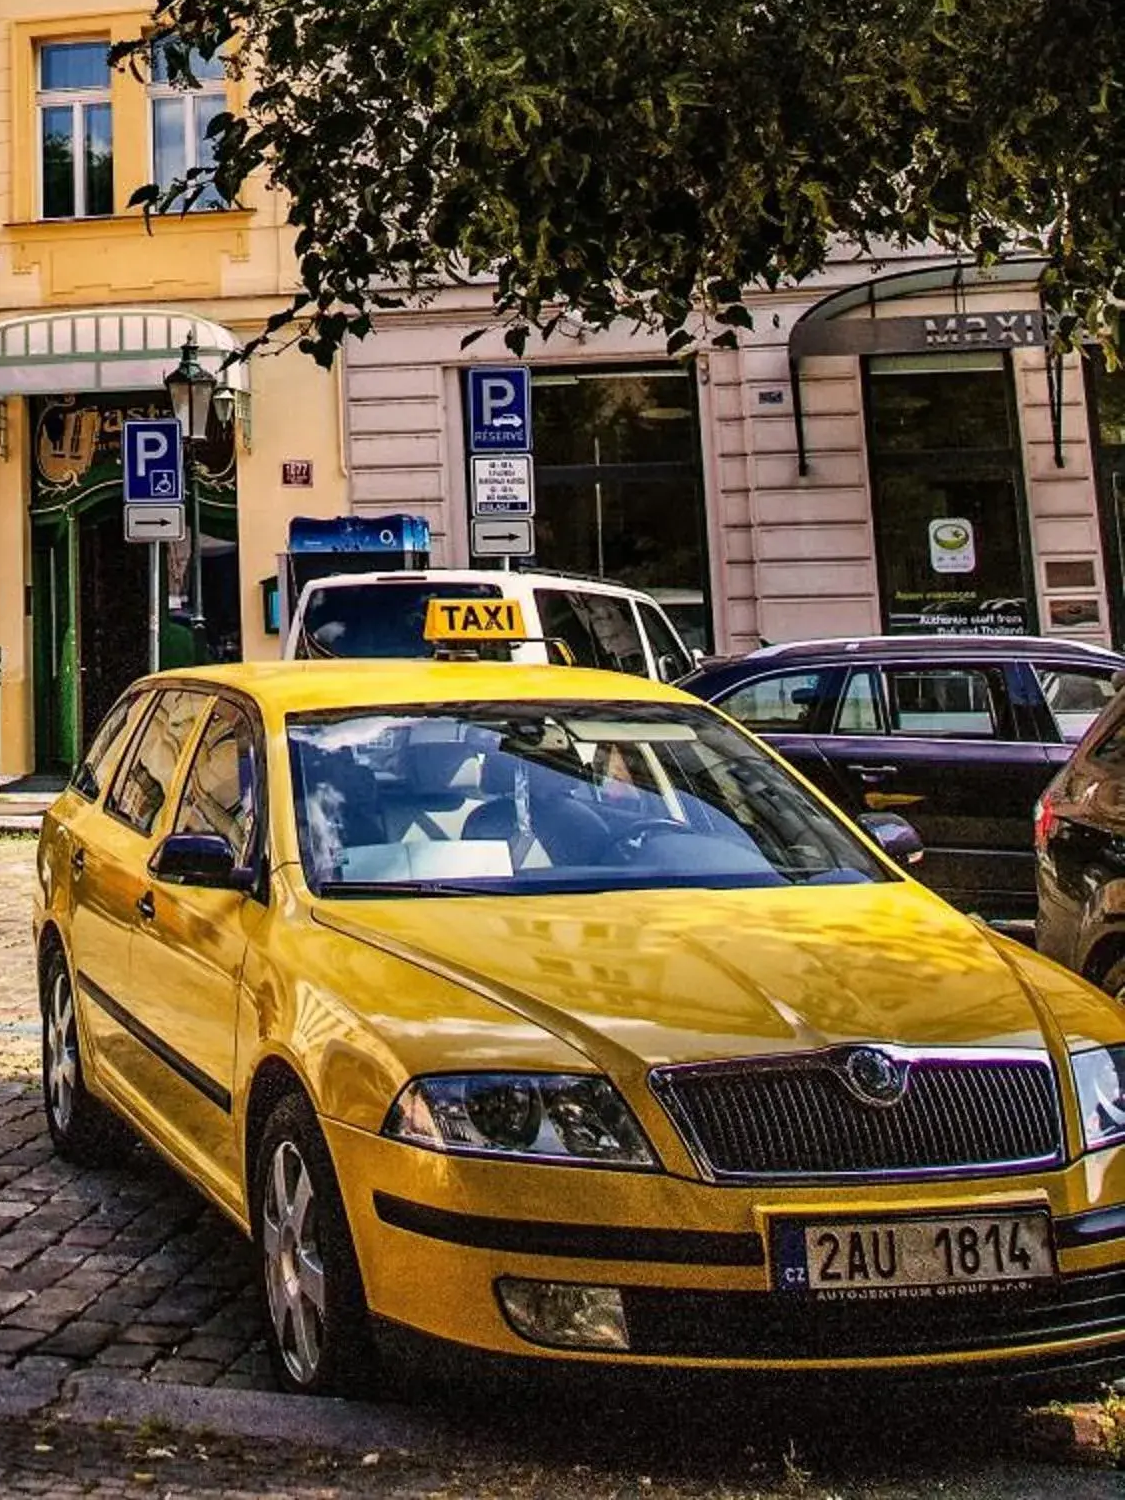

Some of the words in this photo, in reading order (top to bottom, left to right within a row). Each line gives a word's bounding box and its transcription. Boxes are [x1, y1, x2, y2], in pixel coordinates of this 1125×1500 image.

[482, 379, 516, 426] P
[136, 431, 169, 477] P
[440, 605, 515, 631] TAXI
[816, 1229, 898, 1282] 2AU
[934, 1221, 1032, 1277] 1814
[784, 1266, 806, 1283] CZ
[936, 1284, 987, 1298] GROUP
